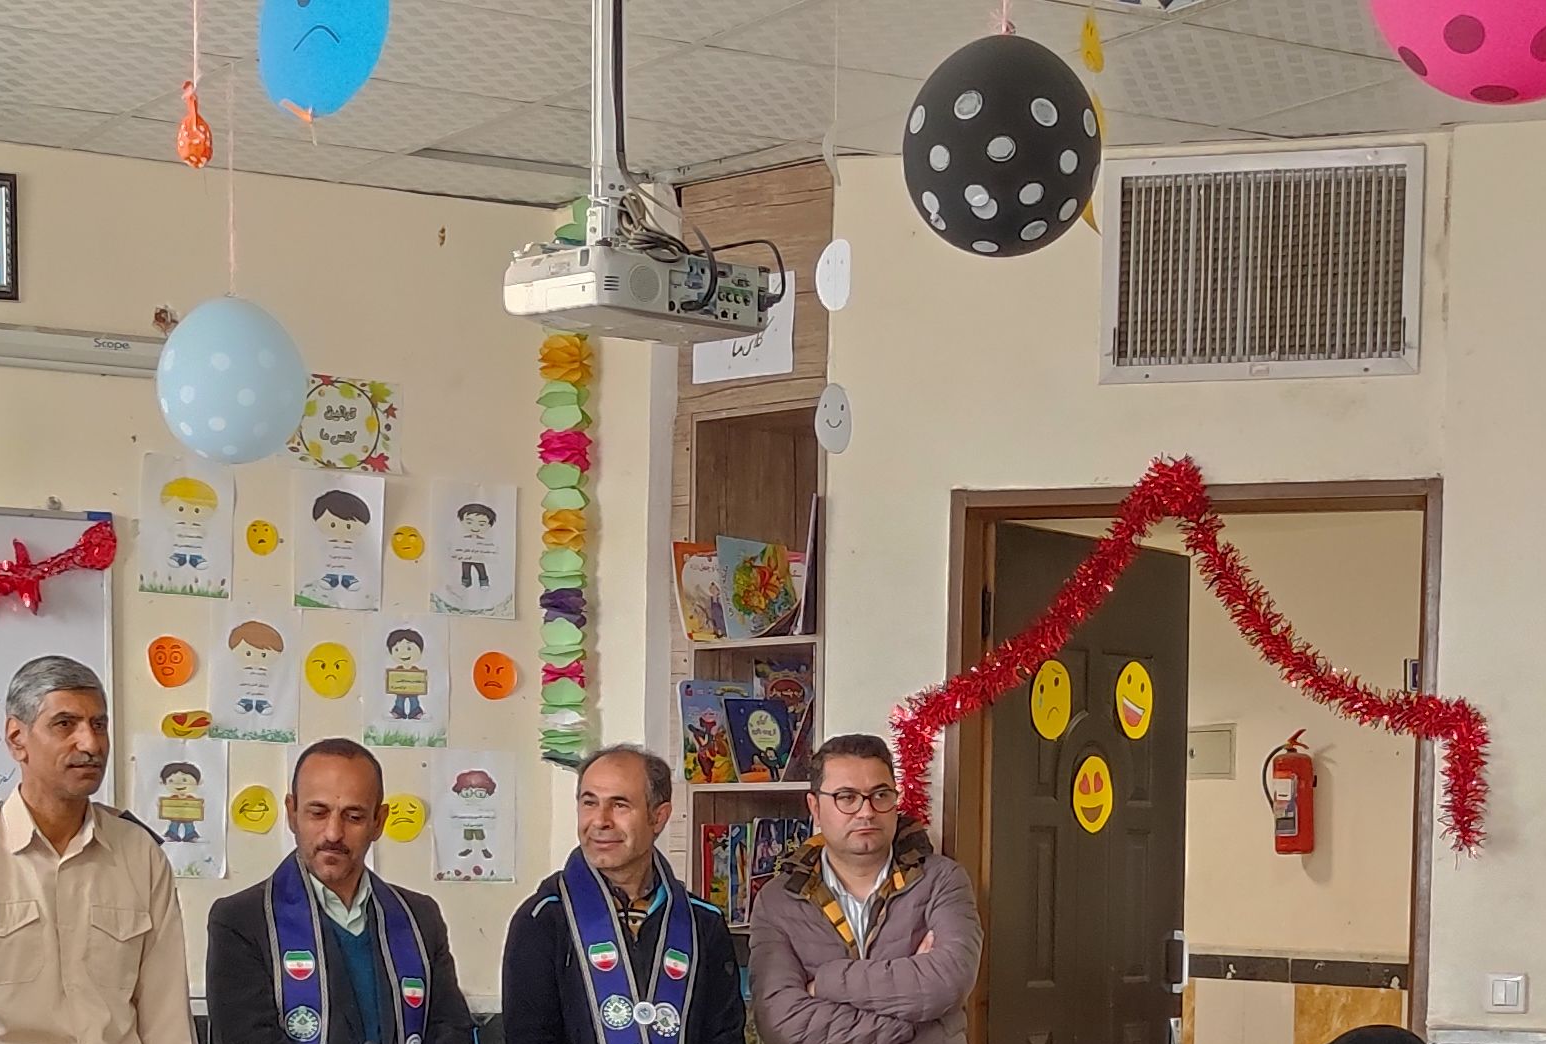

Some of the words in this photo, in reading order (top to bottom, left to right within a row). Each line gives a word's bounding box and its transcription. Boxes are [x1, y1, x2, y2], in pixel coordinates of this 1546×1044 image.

[93, 338, 131, 350] Scope
[323, 405, 357, 422] قوانین
[319, 428, 330, 441] ما
[330, 430, 358, 446] کلاس
